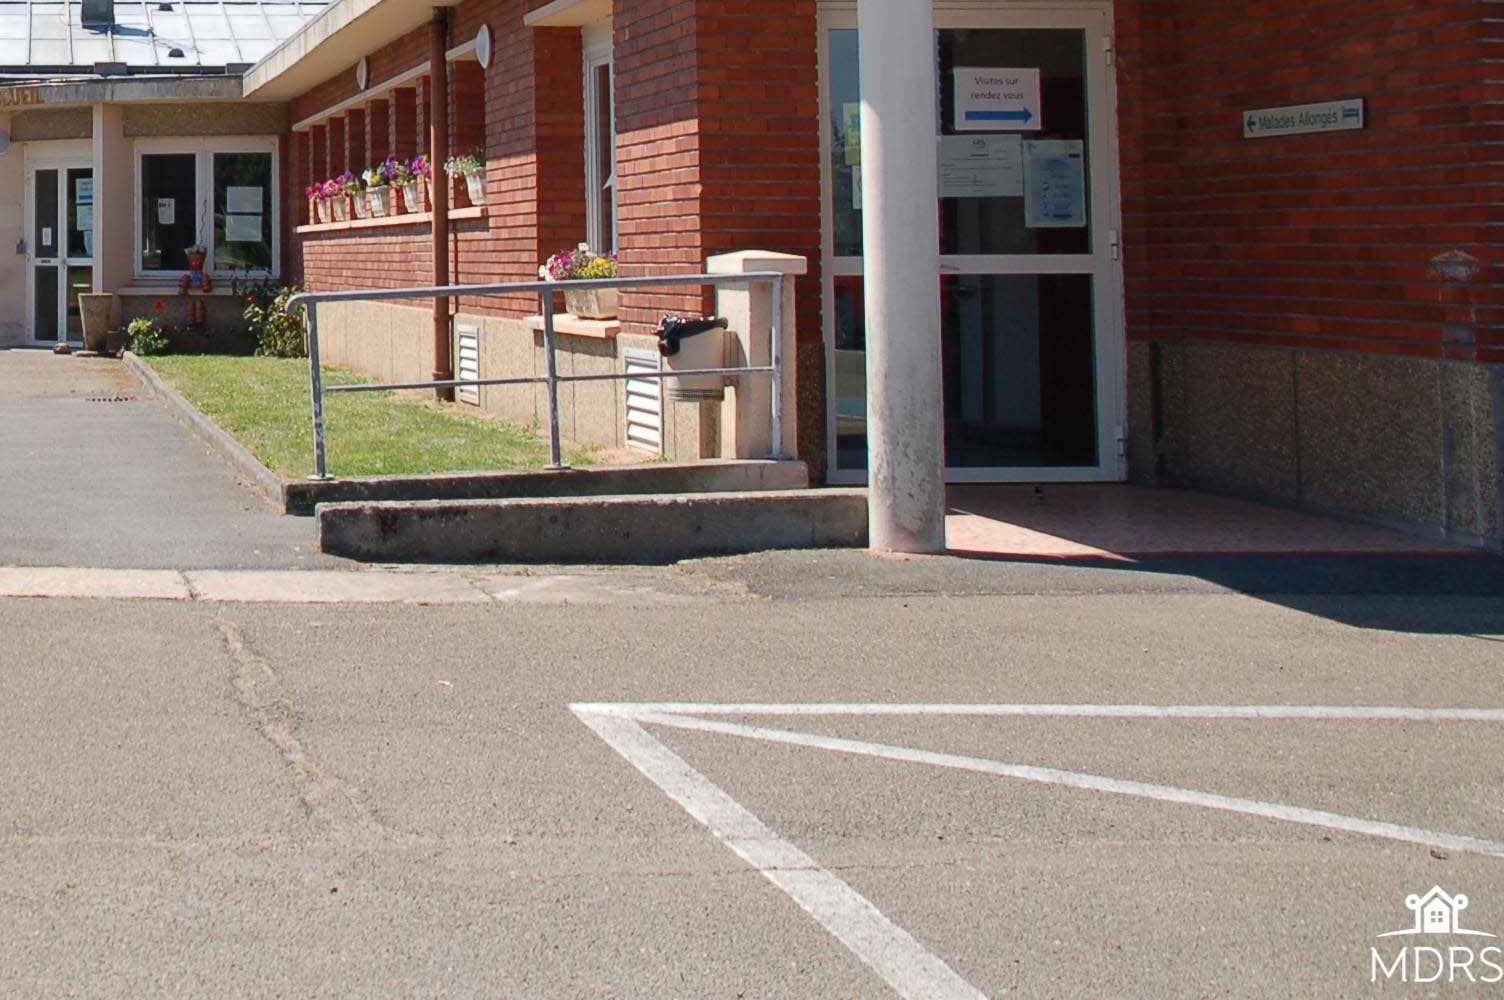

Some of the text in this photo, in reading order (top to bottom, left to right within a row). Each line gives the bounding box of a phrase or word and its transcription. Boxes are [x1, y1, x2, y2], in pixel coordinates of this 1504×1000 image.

[974, 75, 1019, 86] Visites sur
[970, 90, 1024, 100] rendez vous
[1258, 113, 1295, 130] Malades
